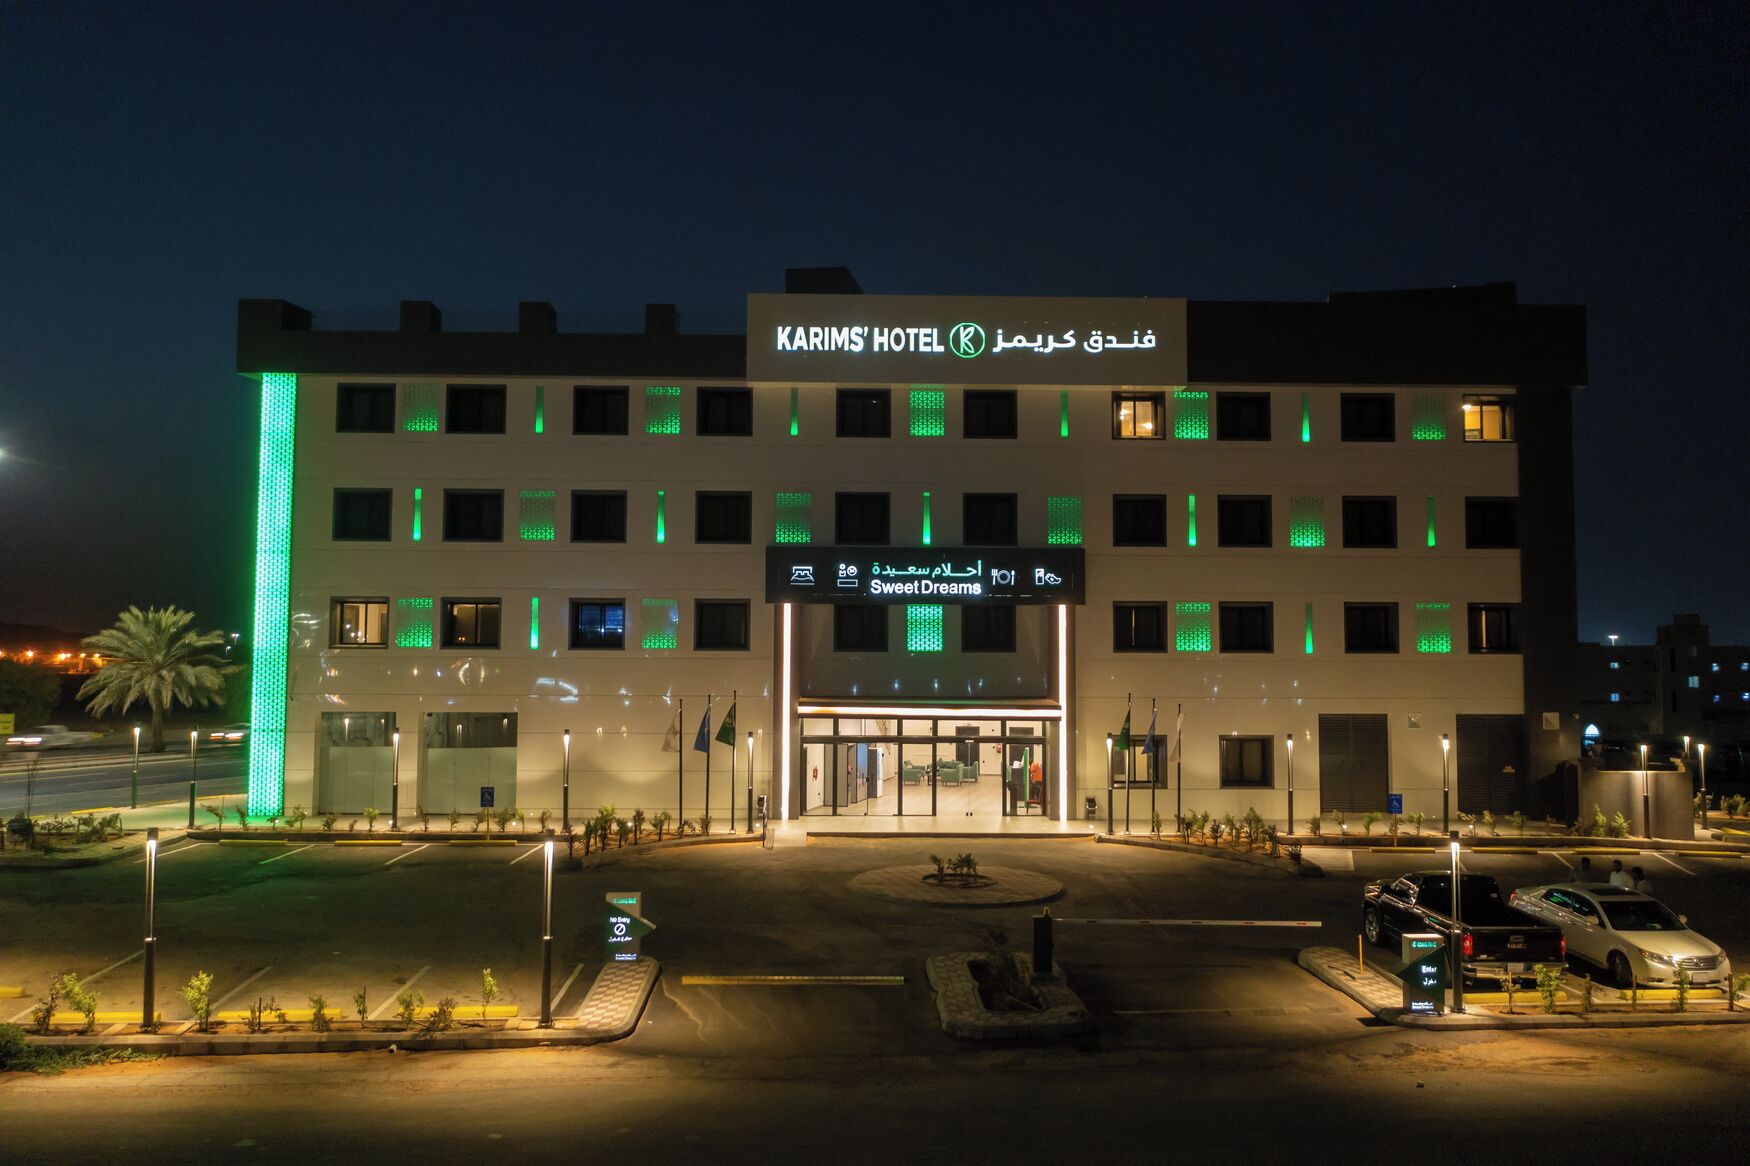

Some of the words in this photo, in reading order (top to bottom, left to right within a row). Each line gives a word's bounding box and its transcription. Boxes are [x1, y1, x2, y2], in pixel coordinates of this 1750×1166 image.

[777, 325, 869, 352] KARIMS'
[873, 327, 945, 352] HOTEL
[992, 328, 1076, 353] كريمز
[1083, 329, 1156, 353] فندق
[871, 562, 930, 577] سعيدة
[931, 559, 982, 578] أحلام
[870, 579, 919, 594] Sweet
[921, 579, 982, 595] Dreams
[617, 916, 631, 924] Entry
[1421, 965, 1438, 973] Enter
